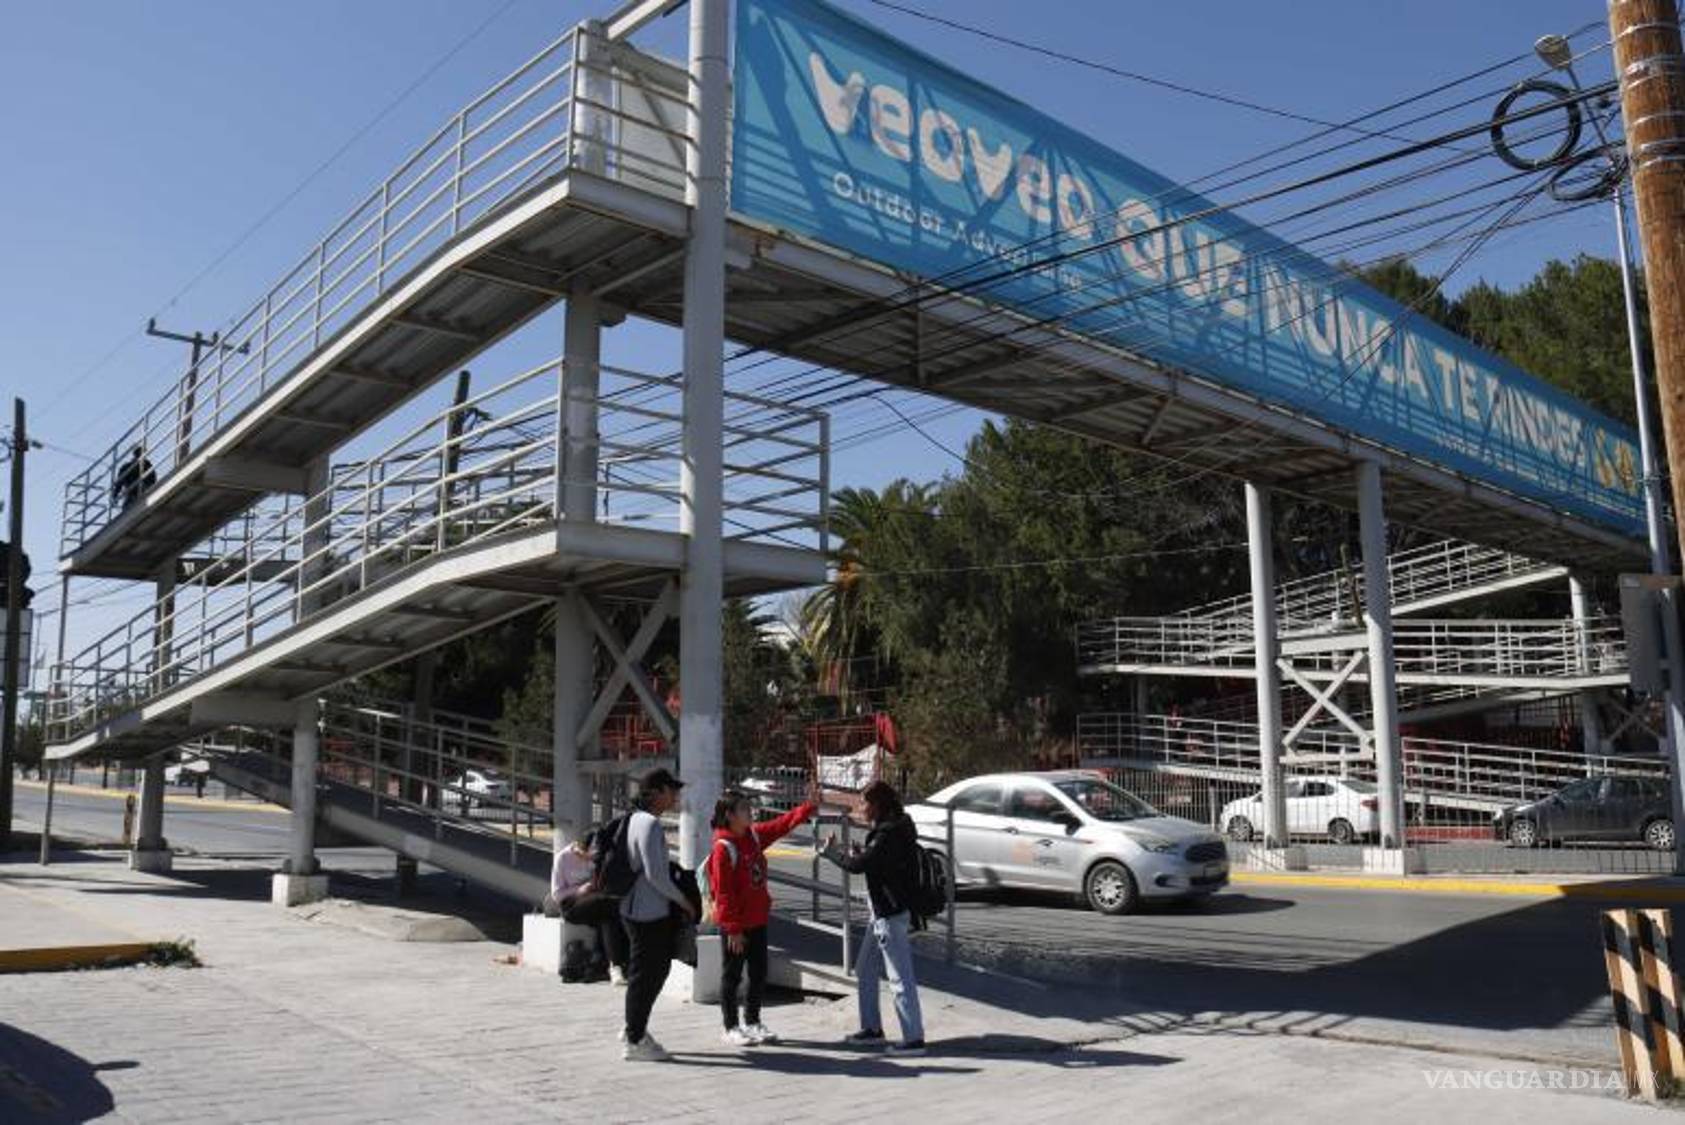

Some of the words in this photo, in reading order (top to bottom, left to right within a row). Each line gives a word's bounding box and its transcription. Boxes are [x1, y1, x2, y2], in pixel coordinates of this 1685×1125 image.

[1115, 198, 1247, 318] QUE
[1263, 261, 1429, 399] NUNCA
[1434, 348, 1481, 421] TE
